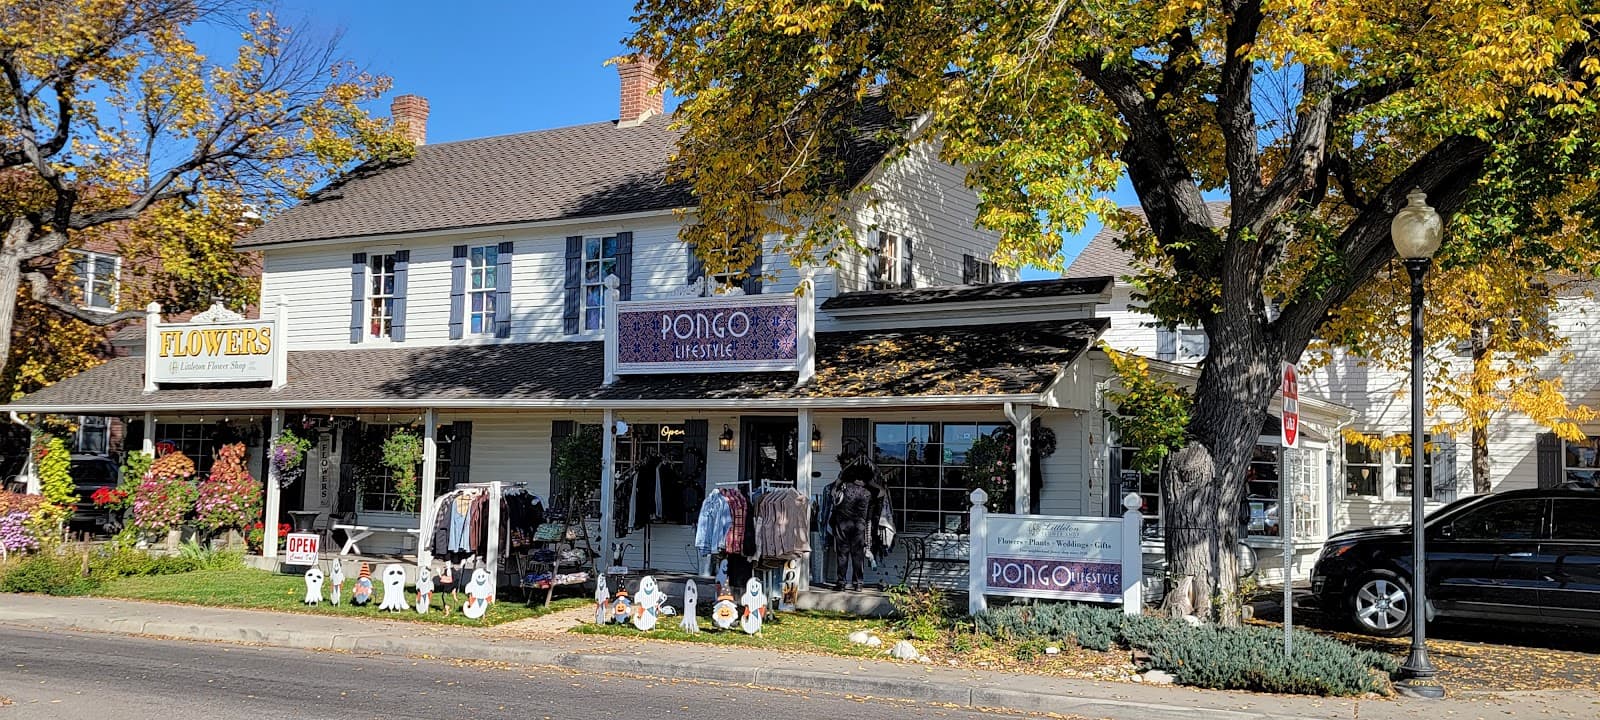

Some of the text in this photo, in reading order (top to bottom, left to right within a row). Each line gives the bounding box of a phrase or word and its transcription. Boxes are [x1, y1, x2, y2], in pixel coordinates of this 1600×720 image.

[660, 311, 750, 340] PONGO
[159, 327, 271, 357] FLOWERS
[675, 343, 733, 359] LIFESTYLE
[180, 361, 205, 371] Littleton
[207, 361, 228, 370] Flower
[230, 360, 247, 372] Shop
[327, 419, 354, 430] SHOP
[660, 425, 686, 442] Open
[321, 444, 329, 498] FLOWERS
[289, 537, 317, 553] OPEN
[997, 537, 1112, 550] Flowers Plants Weddings Gifts
[992, 562, 1118, 587] PONGO LIFESTYLE
